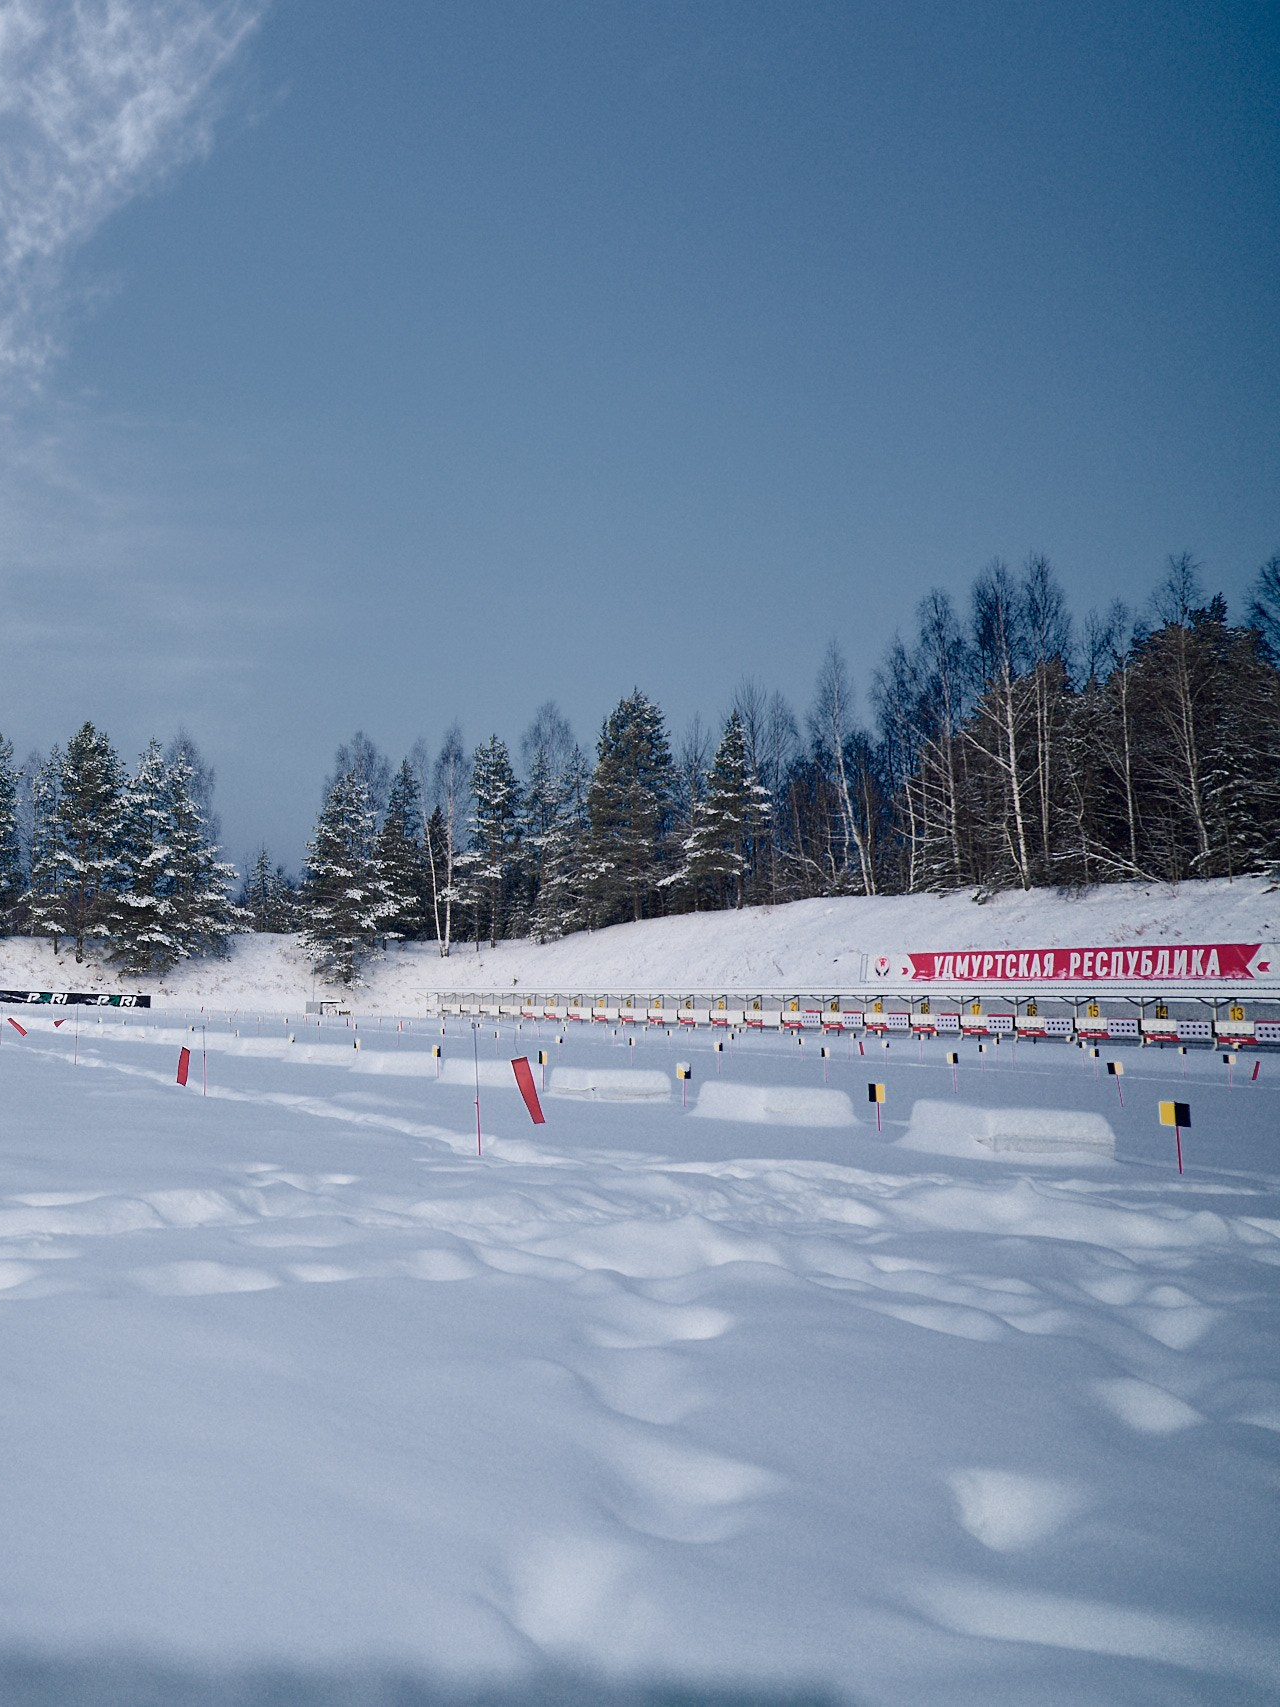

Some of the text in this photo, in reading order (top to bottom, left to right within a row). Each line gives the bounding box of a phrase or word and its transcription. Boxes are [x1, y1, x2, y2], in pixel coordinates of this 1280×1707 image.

[933, 948, 1221, 980] УДМУРТСКАЯ РЕСПУБЛИКА
[26, 992, 68, 1005] PARI
[96, 995, 137, 1008] PARI
[874, 1002, 882, 1012] 19
[971, 1004, 980, 1015] 17
[1027, 1004, 1037, 1016] 16
[1088, 1005, 1099, 1017] 15
[1156, 1007, 1168, 1018] 14
[1230, 1007, 1244, 1020] 13
